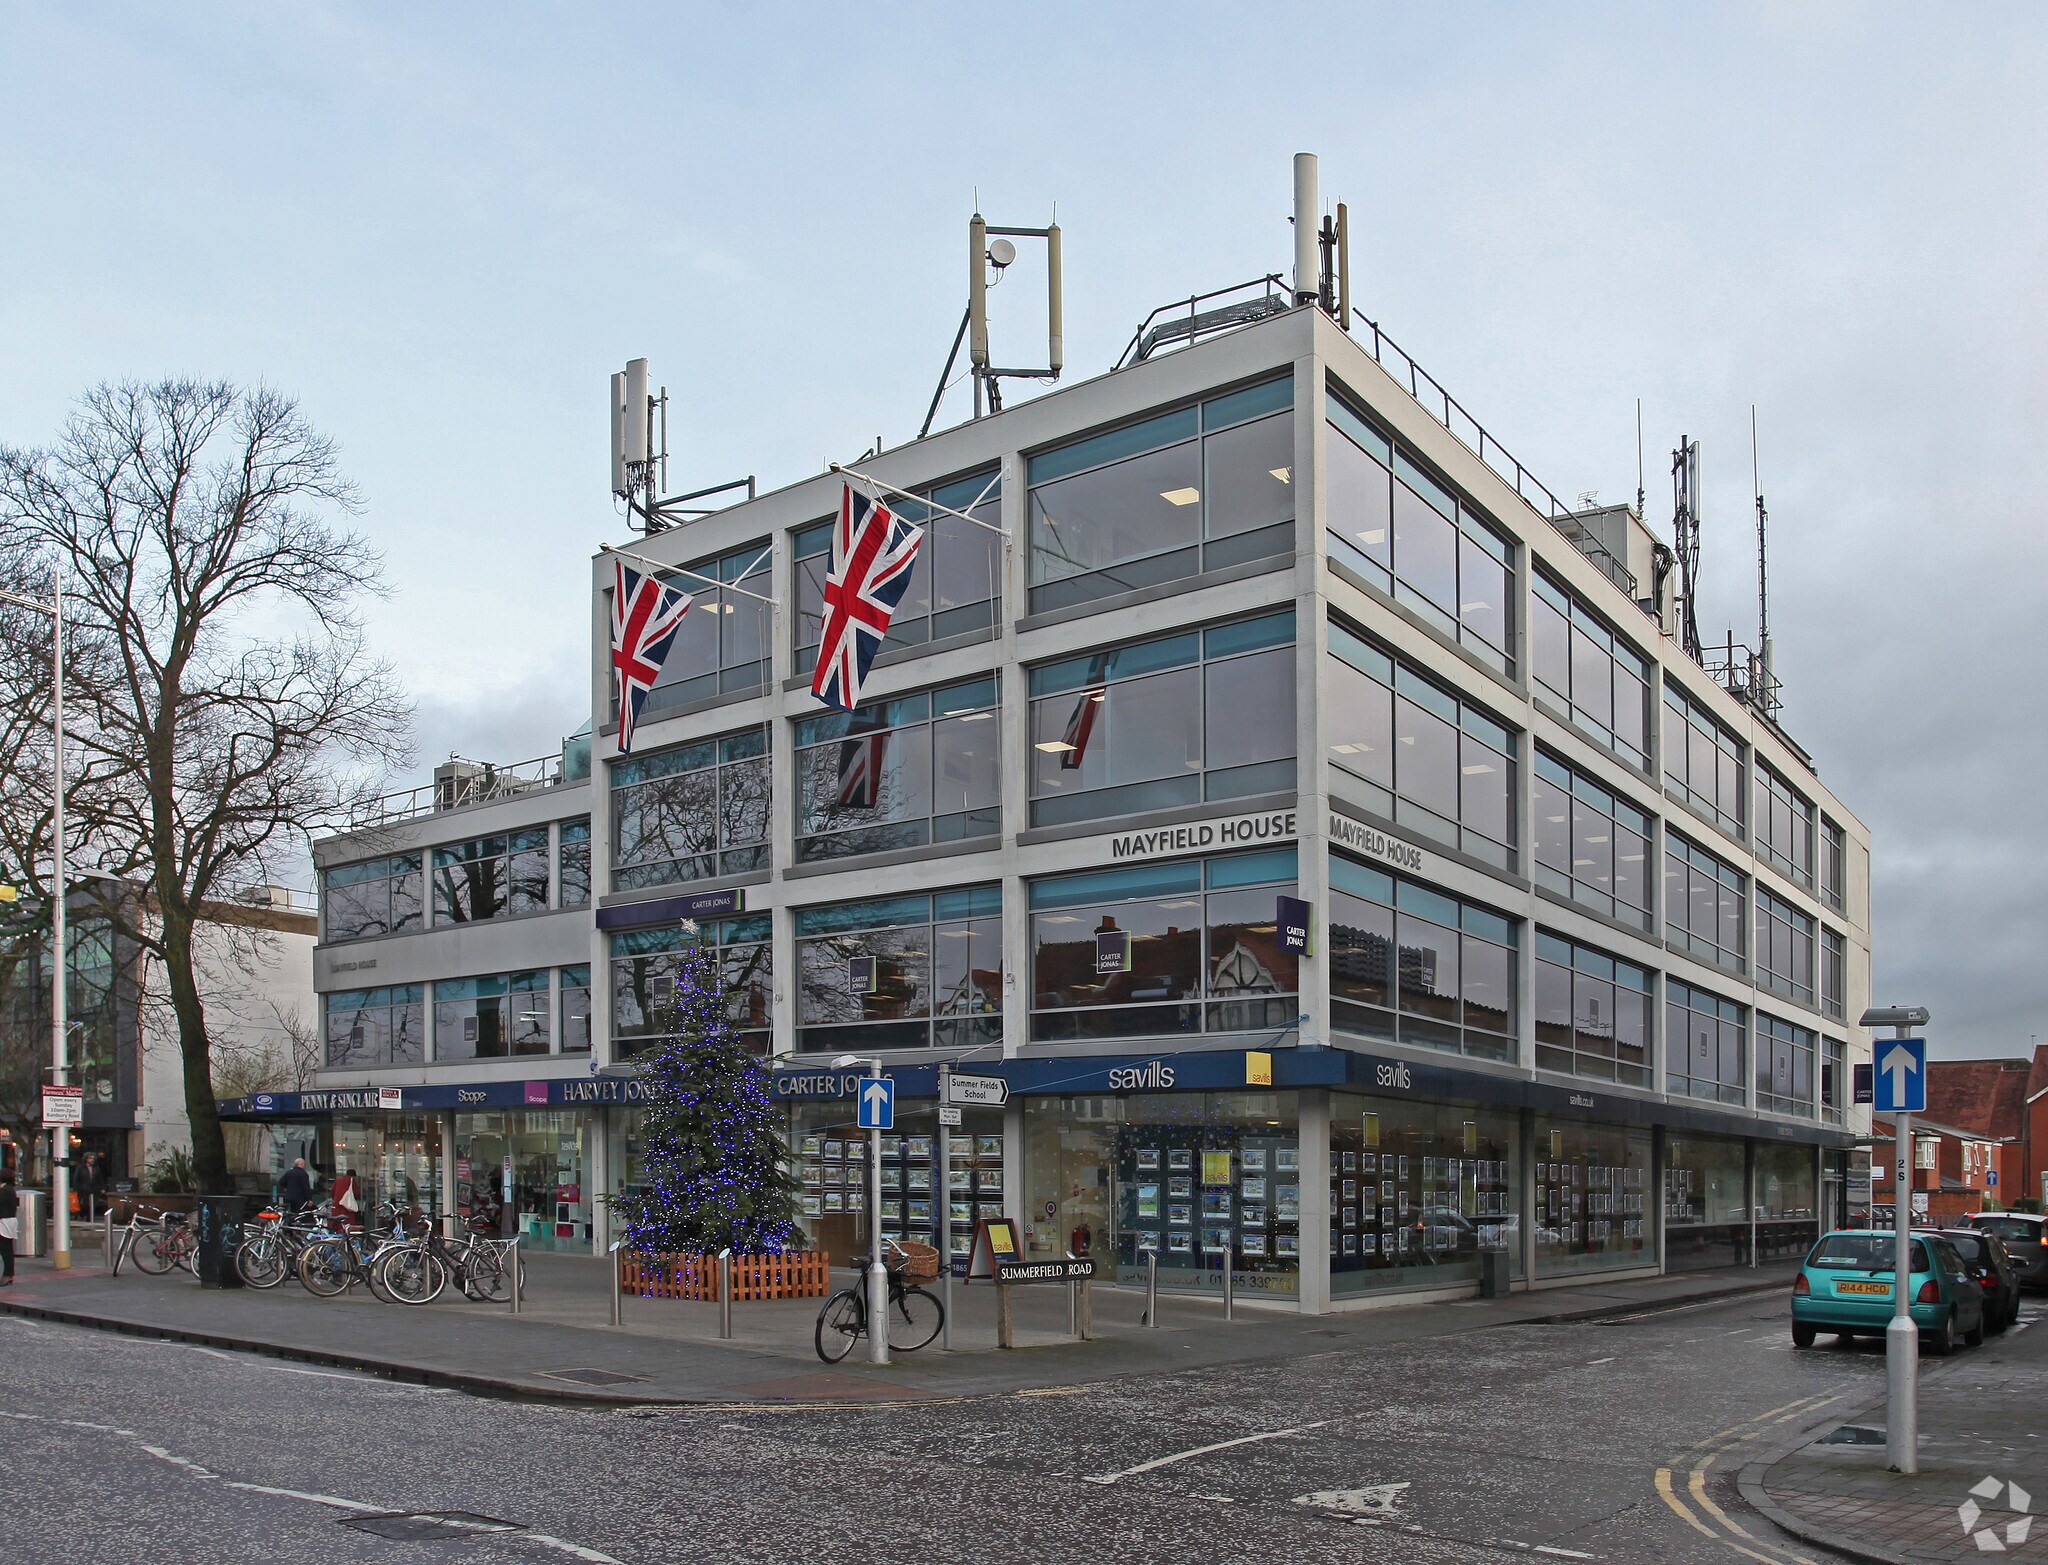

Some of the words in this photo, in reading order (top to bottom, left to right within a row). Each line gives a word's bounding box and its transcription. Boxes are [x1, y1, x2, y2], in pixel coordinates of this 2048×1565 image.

[1112, 824, 1214, 858] MAYFIELD
[1221, 813, 1296, 843] HOUSE
[1329, 815, 1385, 855] MAYFIELD
[1387, 839, 1422, 871] HOUSE
[691, 899, 712, 909] CARTER
[713, 897, 731, 908] JONAS
[1286, 926, 1306, 937] CARTER
[1286, 936, 1304, 947] JONAS
[1100, 953, 1122, 961] CARTER
[1100, 961, 1119, 970] JONAS
[851, 982, 867, 991] JONAS
[1109, 1061, 1175, 1089] savills
[1252, 1073, 1272, 1084] savills
[1376, 1061, 1411, 1089] savills
[778, 1075, 836, 1095] CARTER
[951, 1078, 978, 1088] Summer
[980, 1080, 998, 1090] Fields
[564, 1081, 618, 1101] HARVEY
[964, 1089, 986, 1099] School
[301, 1094, 328, 1109] PENNY
[330, 1093, 337, 1109] &
[338, 1092, 379, 1108] SINCLAIR
[458, 1089, 487, 1105] Scope
[528, 1095, 547, 1103] Scope
[1897, 1158, 1905, 1169] 2
[1205, 1172, 1228, 1183] savills
[1897, 1171, 1905, 1182] S
[993, 1242, 1013, 1251] savills
[952, 1263, 968, 1272] 1865
[1001, 1265, 1063, 1280] SUMMERFIELD
[1068, 1263, 1092, 1275] ROAD
[1840, 1283, 1863, 1292] R144
